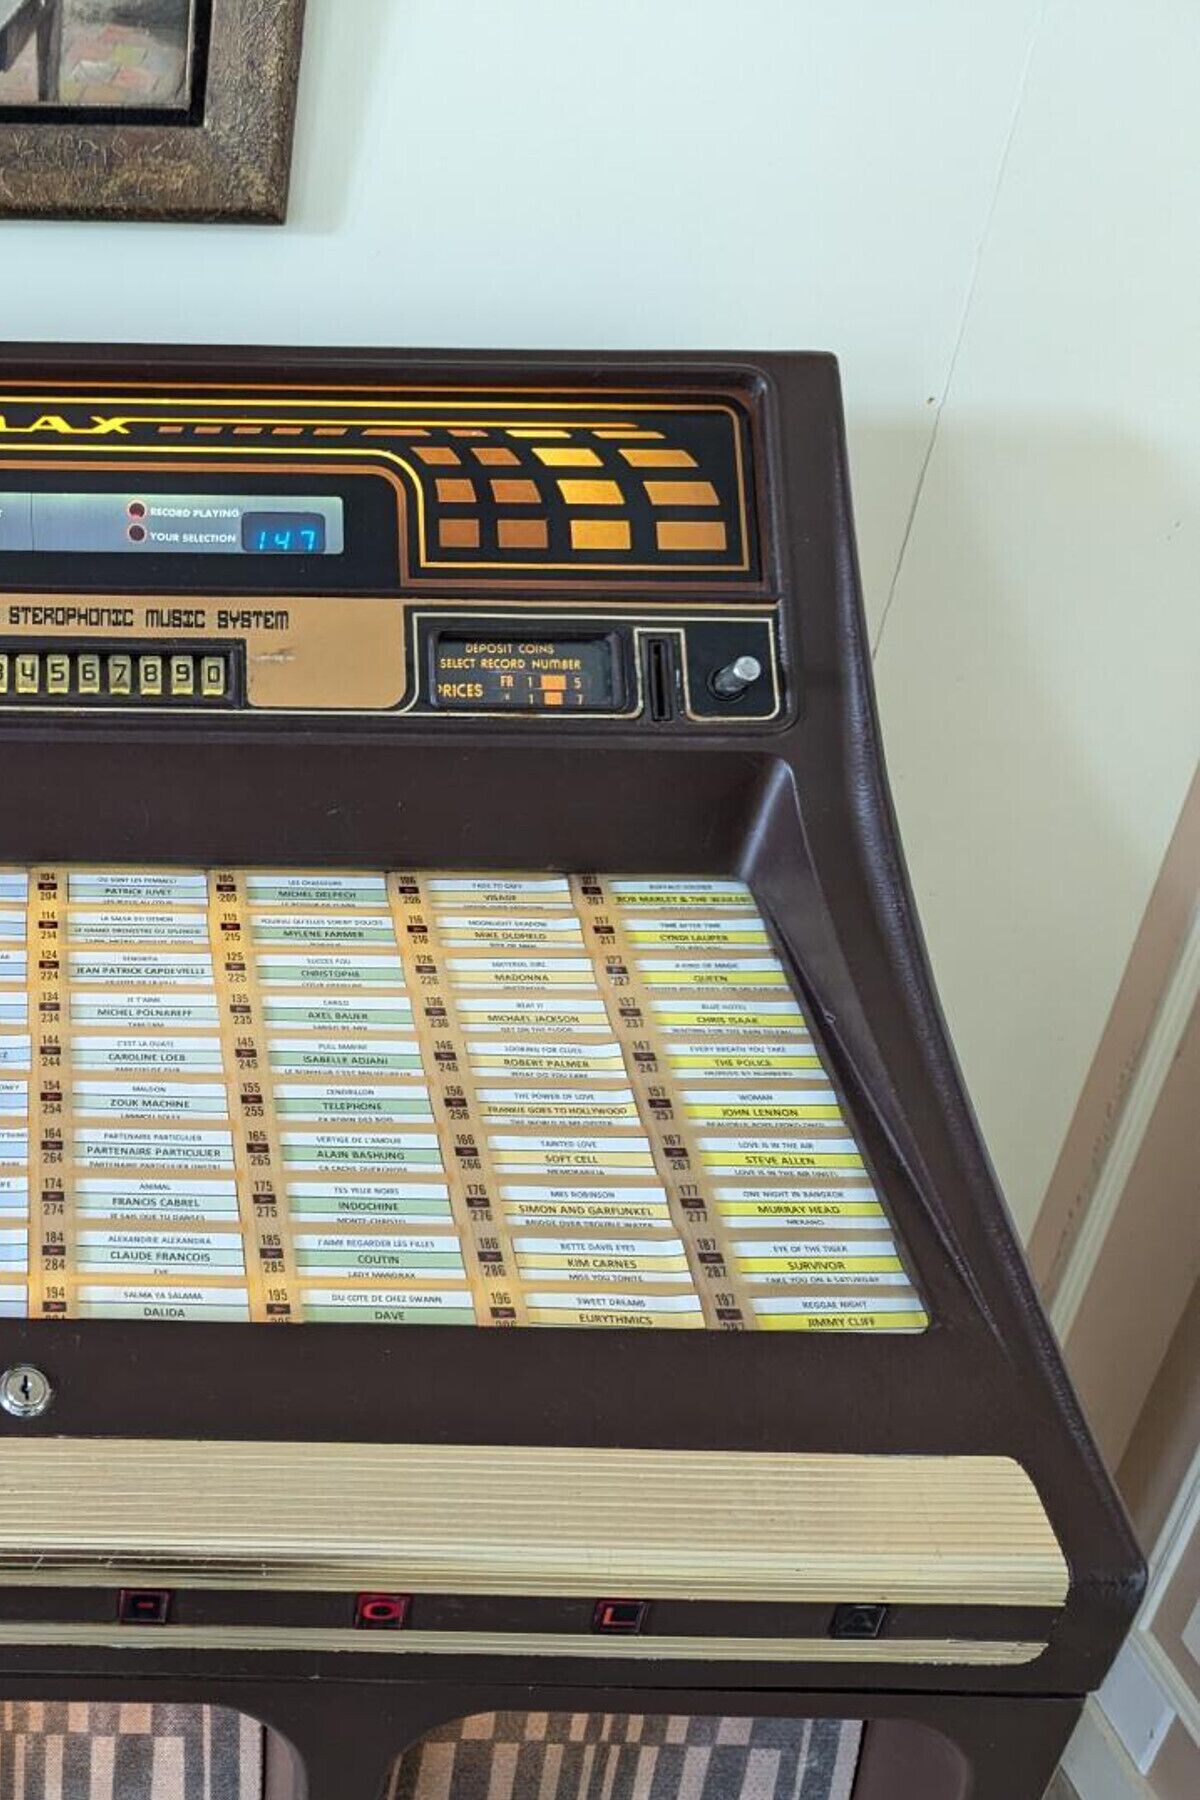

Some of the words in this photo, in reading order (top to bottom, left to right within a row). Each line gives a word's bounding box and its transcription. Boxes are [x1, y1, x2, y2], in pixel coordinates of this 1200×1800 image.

[150, 508, 190, 518] RECORD
[193, 509, 239, 518] PLAYING
[150, 532, 179, 542] YOUR
[182, 533, 236, 543] SELECTION
[259, 531, 315, 551] 147
[9, 606, 134, 626] STEROPHONIC
[145, 609, 205, 628] MUSIC
[217, 610, 288, 629] SYSTEM
[465, 643, 513, 654] DEPOSIT
[518, 643, 554, 654] COINS
[440, 658, 476, 669] SELECT
[480, 658, 525, 669] RECORD
[532, 659, 582, 670] NUMBER
[21, 662, 35, 681] 4
[51, 663, 64, 682] 5
[82, 663, 95, 682] 6
[112, 664, 126, 682] 7
[144, 664, 157, 682] 8
[176, 665, 189, 682] 9
[207, 665, 220, 683] 0
[110, 1099, 139, 1108] ZOUK
[142, 1100, 189, 1108] MACHINE
[753, 1109, 798, 1117] LENNON
[87, 1146, 152, 1156] PARTENAIRE
[156, 1148, 220, 1157] PARTICULIER
[317, 1150, 349, 1158] ALAIN
[352, 1150, 404, 1160] BASHUNG
[545, 1155, 571, 1163] SOFT
[112, 1197, 156, 1206] FRANCIS
[160, 1198, 200, 1207] CABREL
[338, 1202, 398, 1211] INDOCHINE
[519, 1205, 557, 1213] SIMON
[560, 1206, 586, 1214] AND
[588, 1206, 653, 1216] GARFUNKEL
[110, 1251, 152, 1261] CLAUDE
[568, 1259, 590, 1268] KIM
[592, 1260, 637, 1268] CARNES
[787, 1261, 846, 1270] SURVIVOR
[144, 1308, 185, 1318] DALIDA
[374, 1311, 405, 1321] DAVE
[579, 1314, 653, 1324] EURYTHMICS
[382, 1601, 418, 1619] O
[602, 1607, 635, 1626] L
